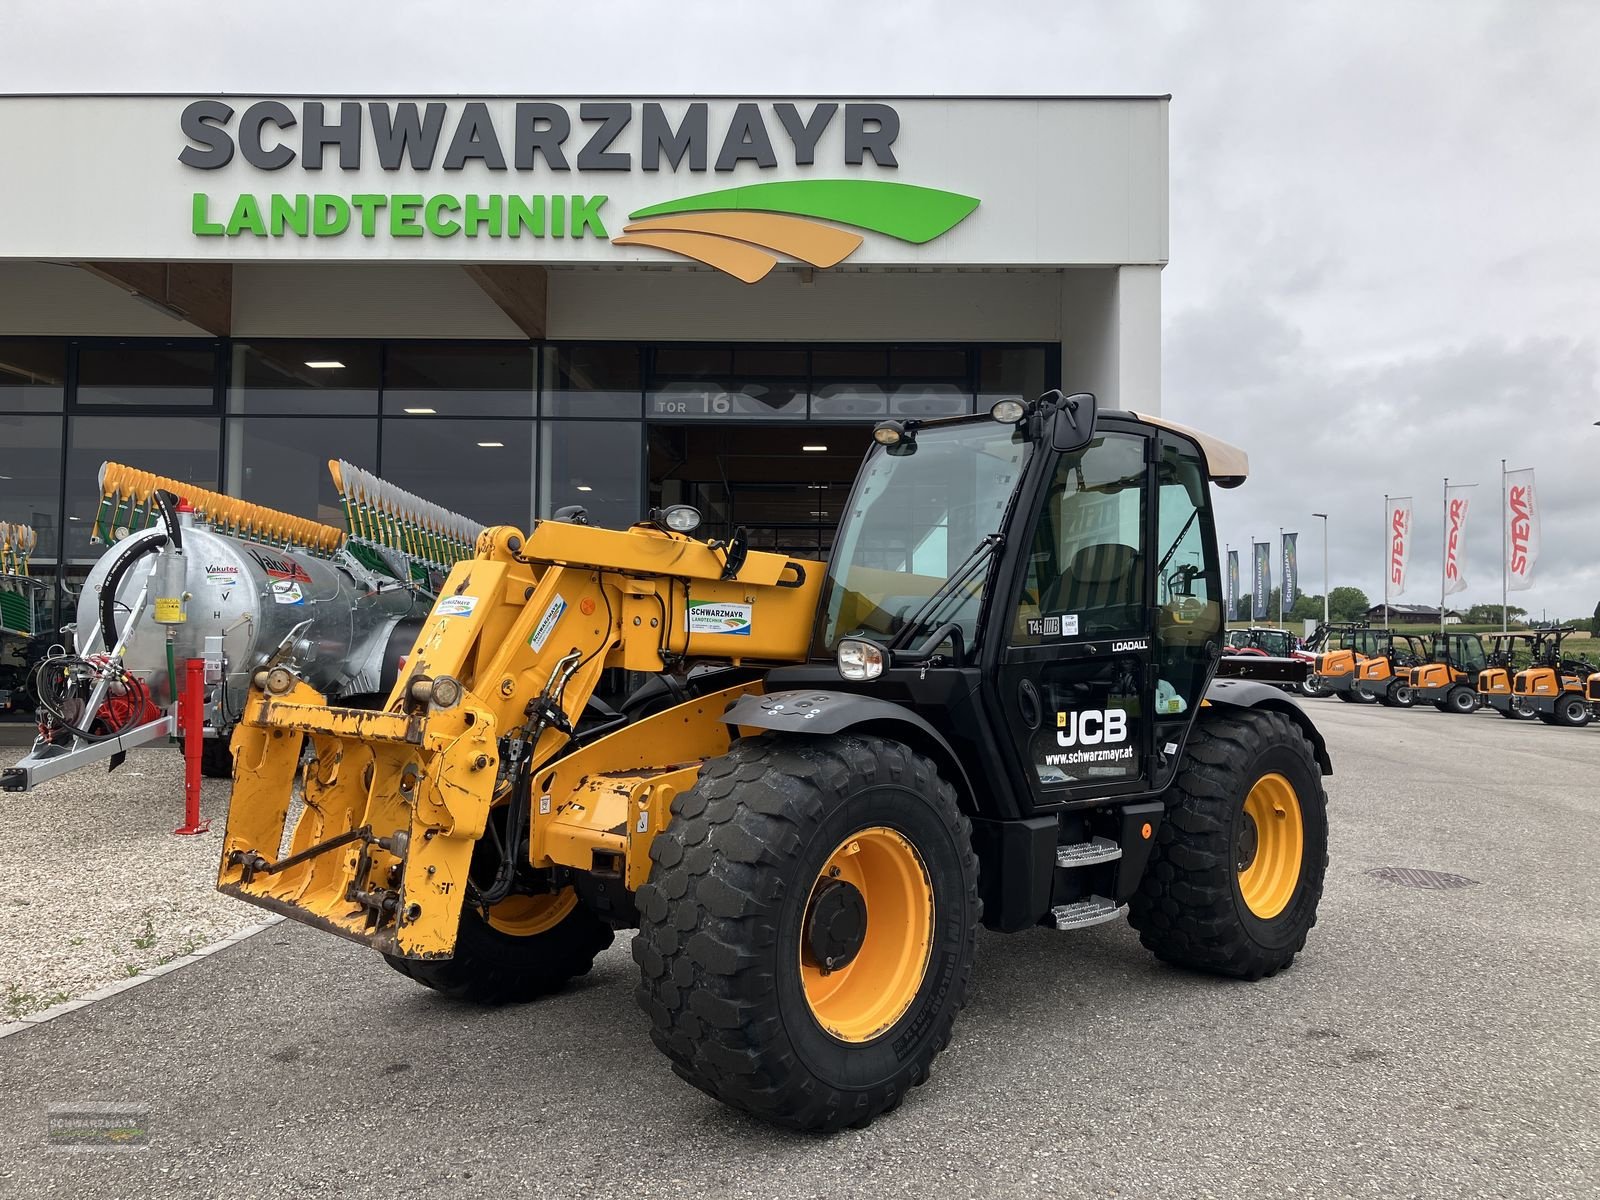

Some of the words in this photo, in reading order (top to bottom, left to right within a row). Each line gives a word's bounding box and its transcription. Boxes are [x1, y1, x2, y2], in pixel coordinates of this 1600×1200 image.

[178, 98, 901, 173] SCHWARZMAYR
[192, 192, 609, 238] LANDTECHNIK
[658, 402, 686, 413] TOR
[701, 392, 730, 413] 16
[1446, 499, 1463, 582] STEYR
[1510, 486, 1530, 575] STEYR
[1391, 509, 1404, 586] STEYR
[205, 564, 239, 574] Vakutec
[222, 592, 230, 601] V
[213, 611, 221, 619] H
[532, 603, 558, 642] SCHWARZMAYR
[691, 608, 743, 618] SCHWARZMAYR
[1028, 620, 1043, 634] T4i
[1112, 640, 1148, 652] LOADALL
[1056, 708, 1127, 747] JCB
[1045, 745, 1133, 766] www.schwarzmayr.at
